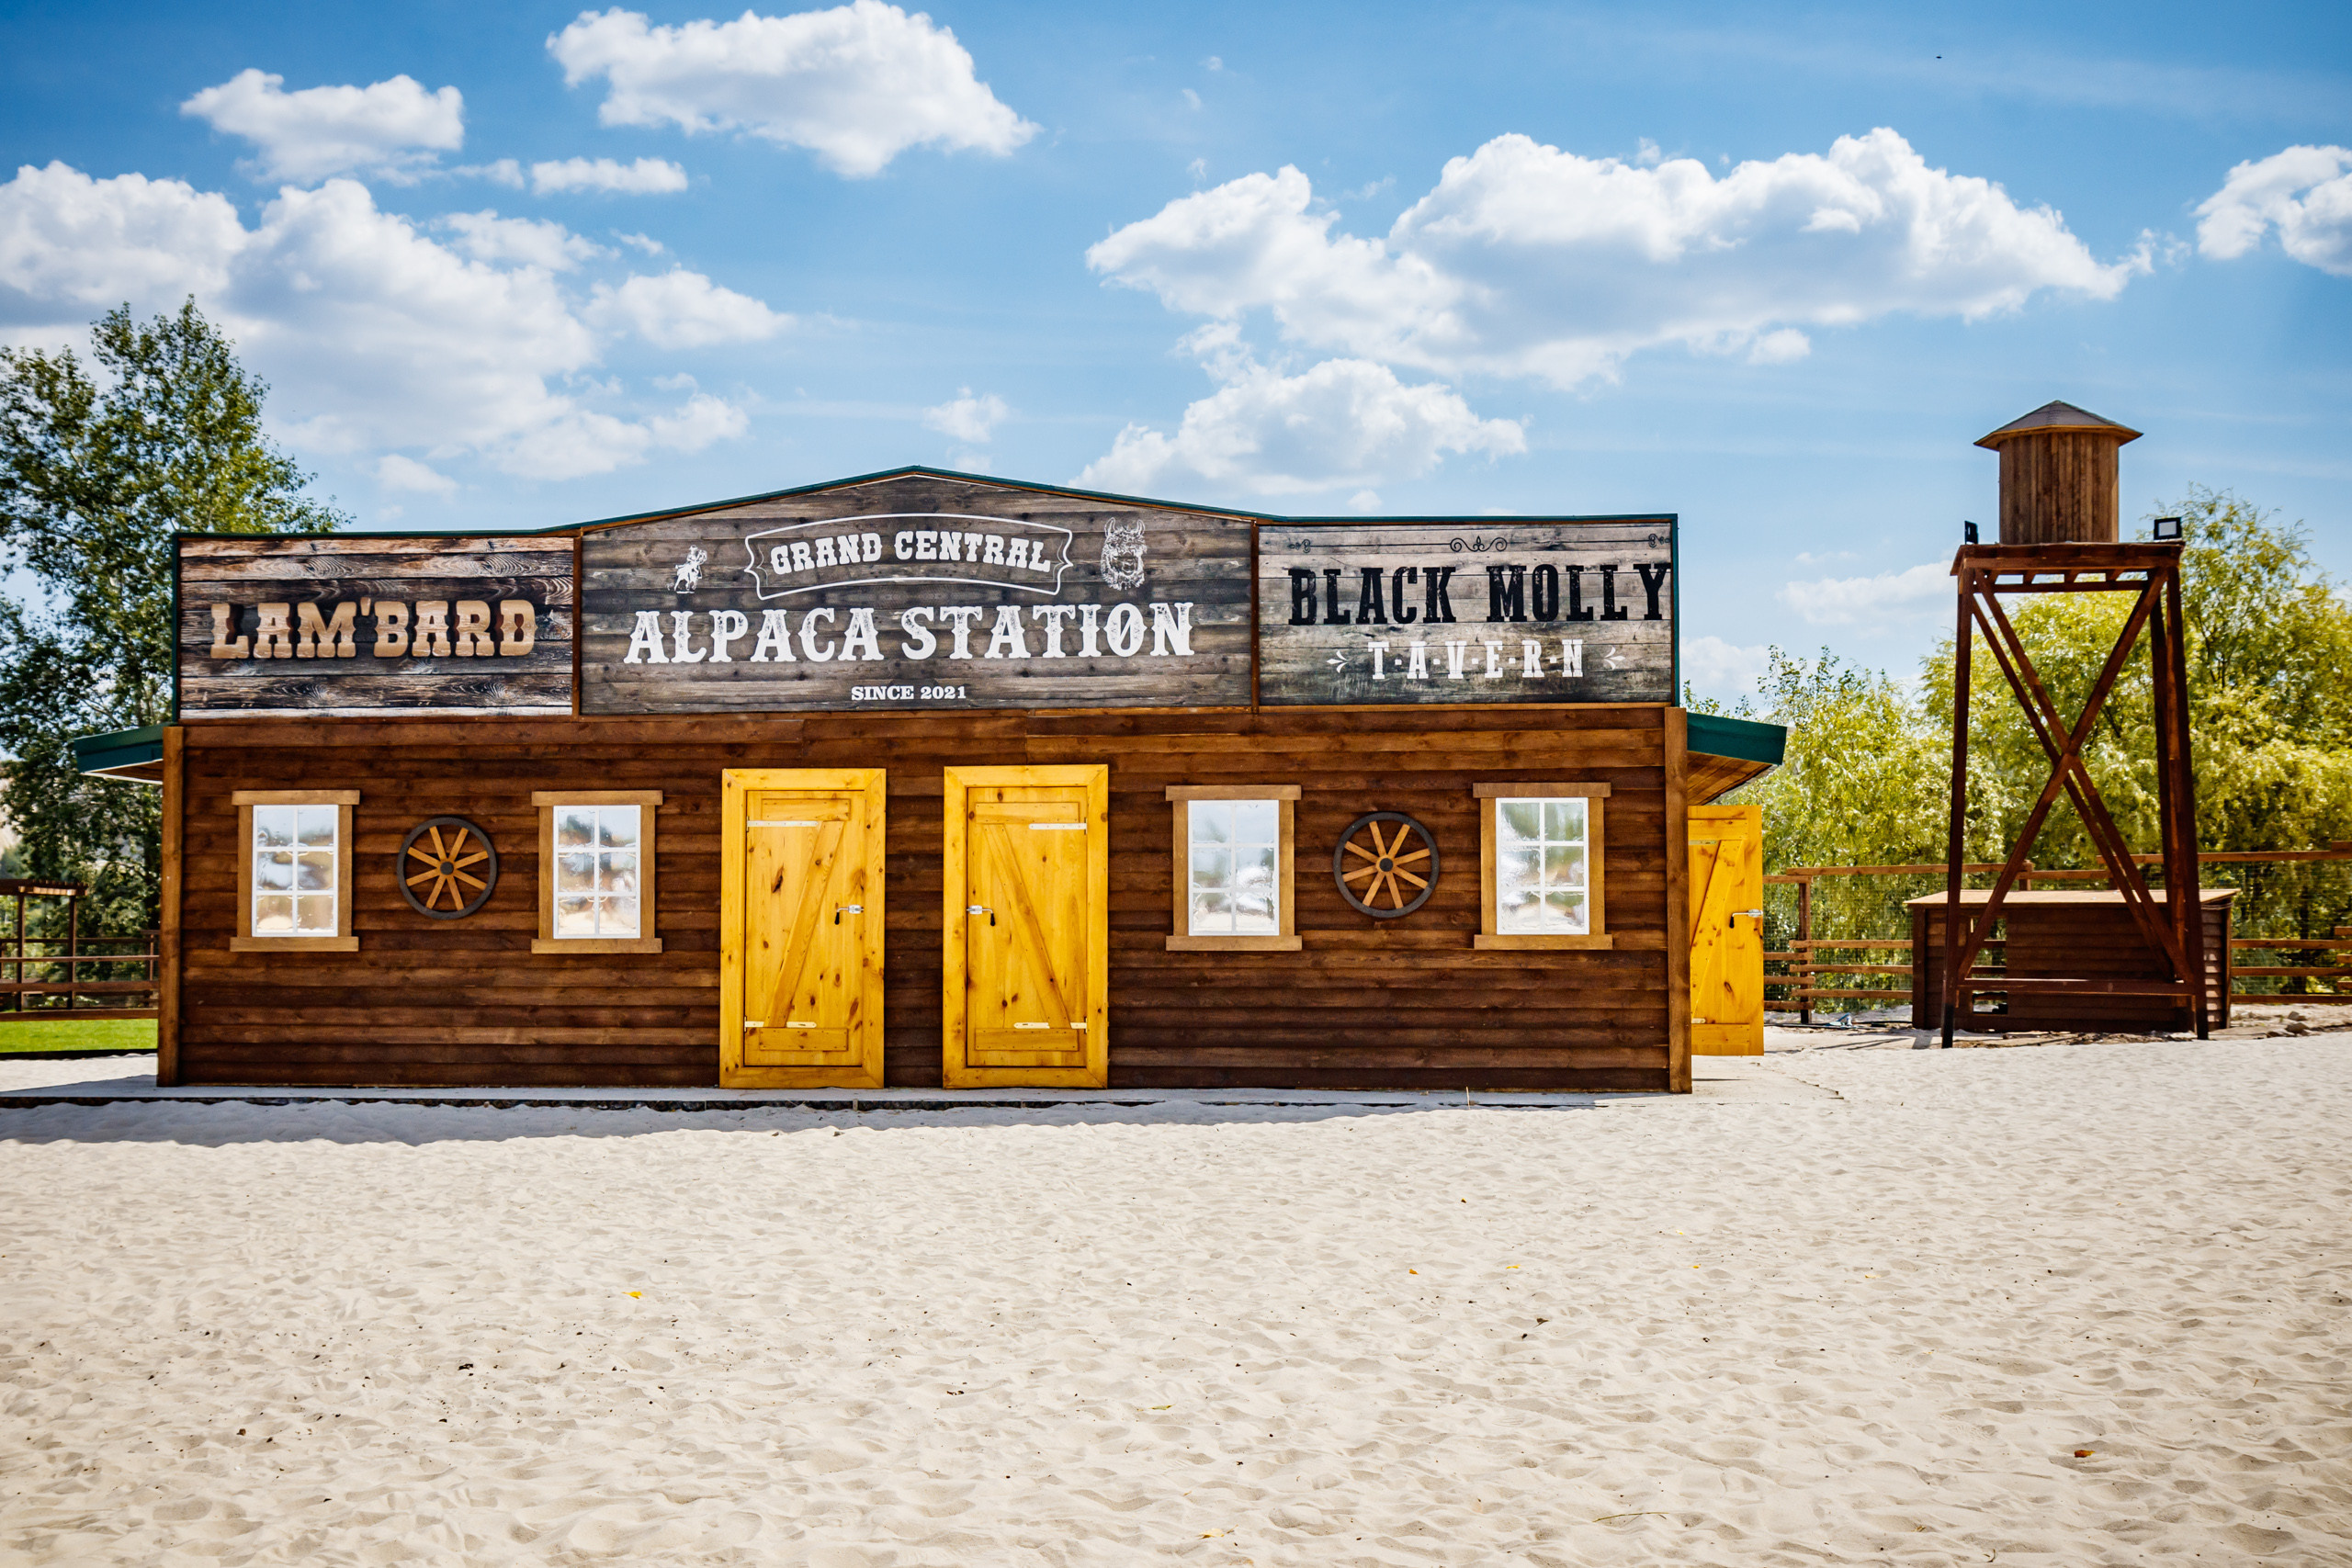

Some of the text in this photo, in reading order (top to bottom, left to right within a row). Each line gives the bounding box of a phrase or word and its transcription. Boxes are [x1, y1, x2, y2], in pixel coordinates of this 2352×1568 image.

[770, 529, 1051, 575] GRAND CENTRAL
[1287, 563, 1671, 626] BLACK MOLLY
[210, 597, 537, 659] LAM'BARD
[623, 607, 885, 664] ALPACA
[851, 686, 967, 700] SINCE 2021
